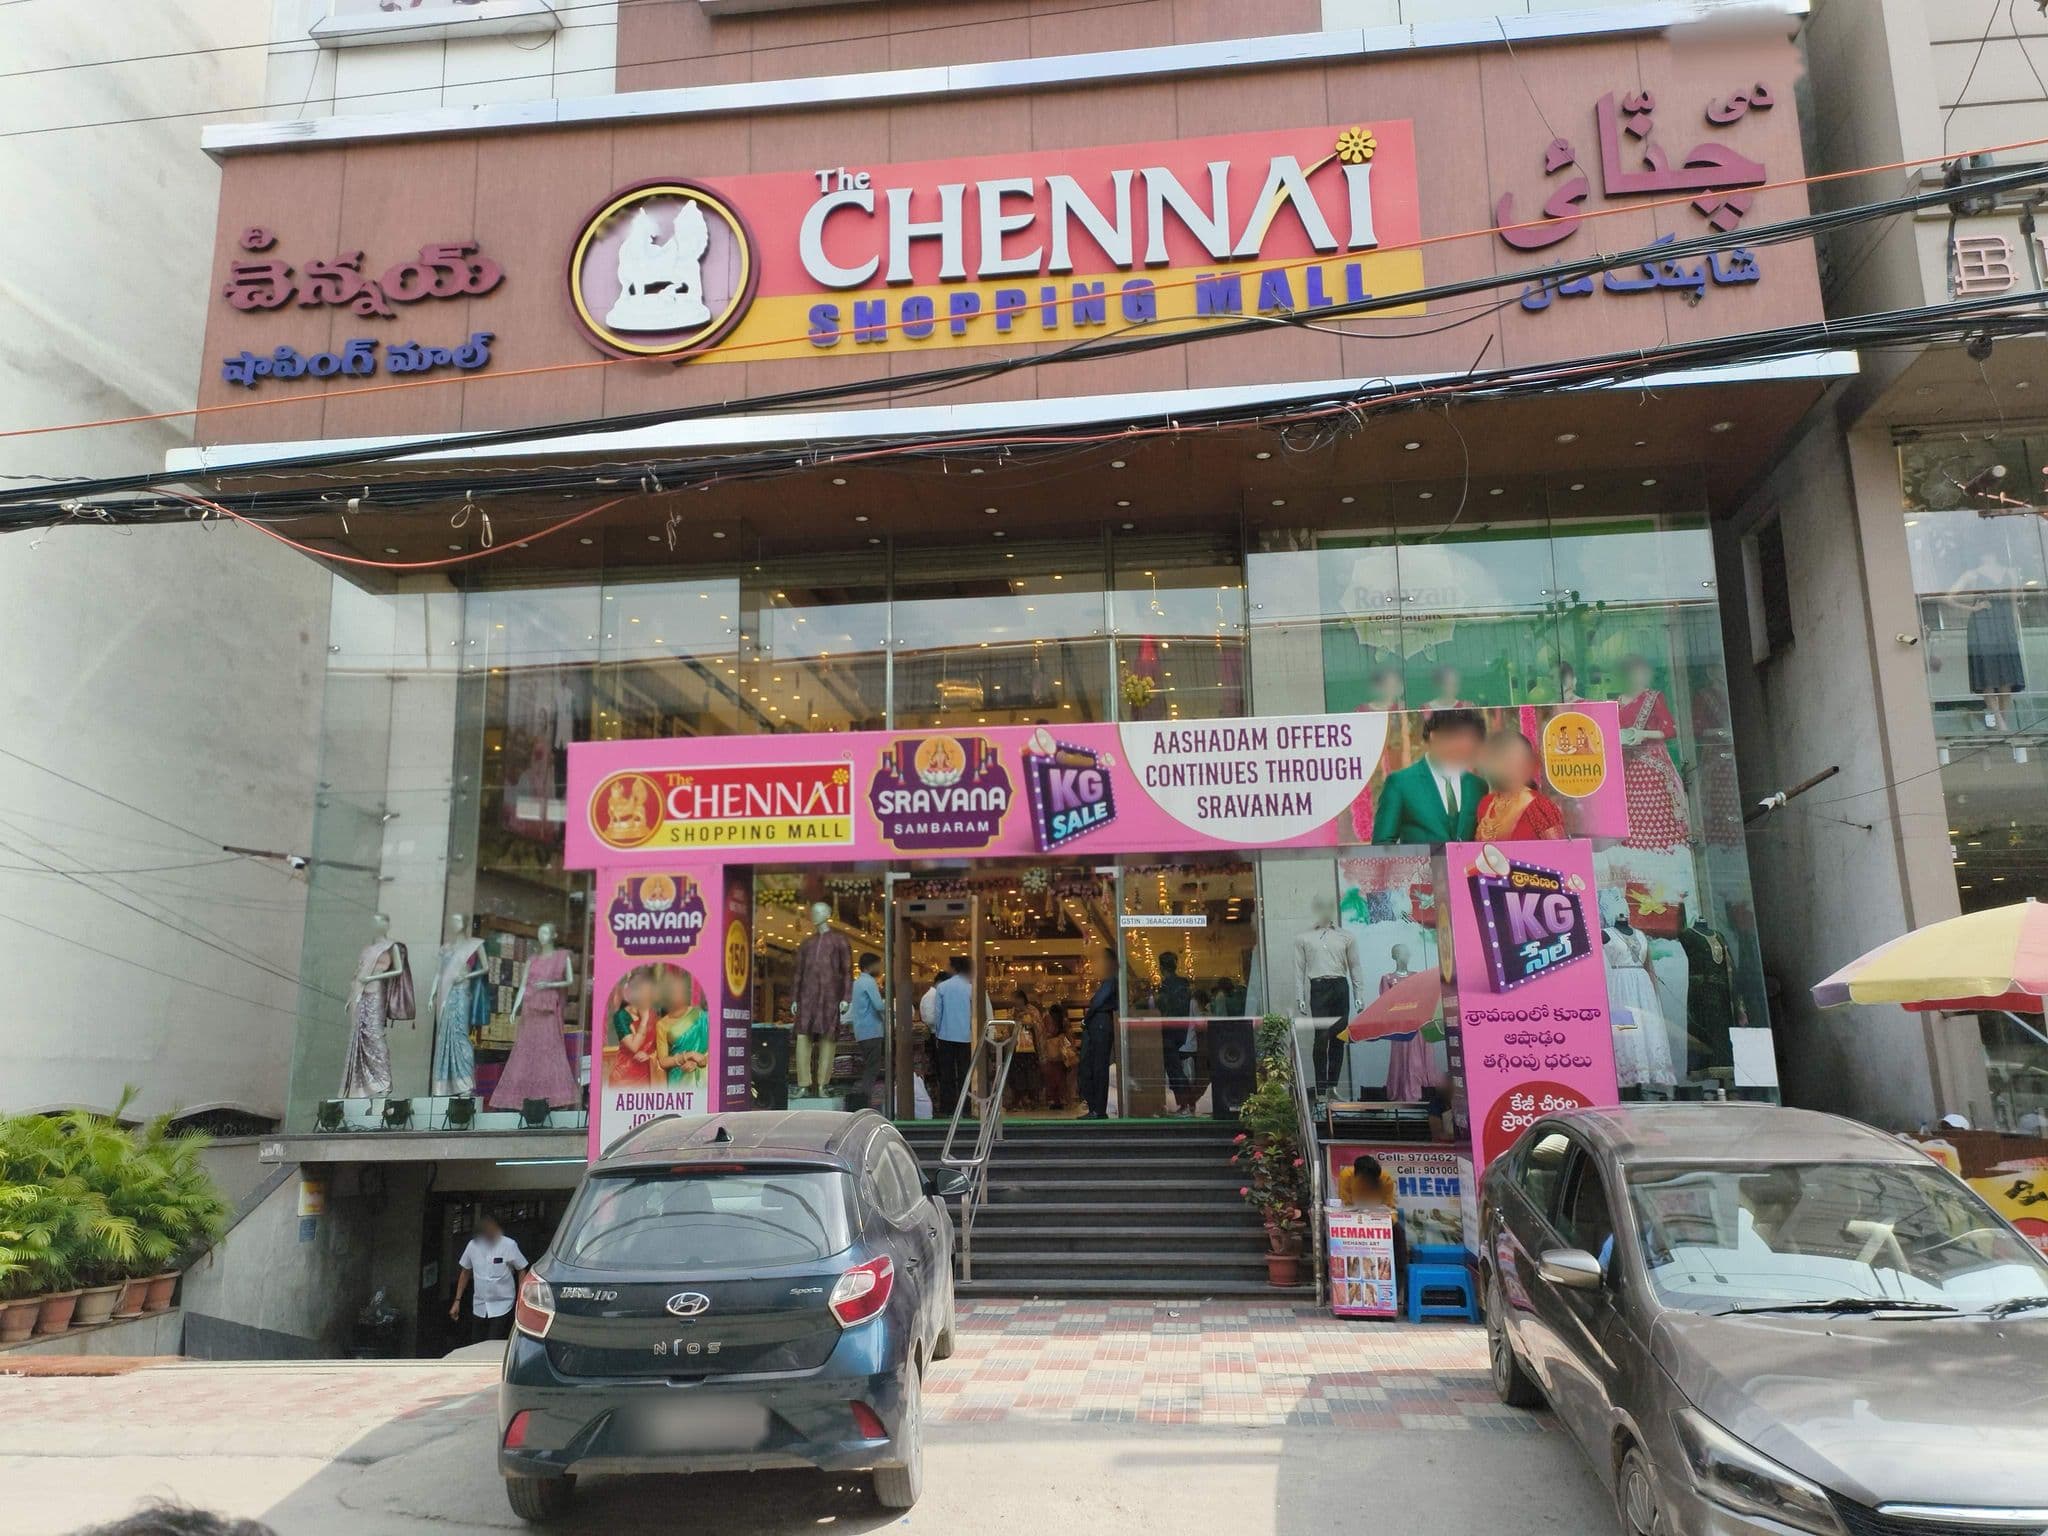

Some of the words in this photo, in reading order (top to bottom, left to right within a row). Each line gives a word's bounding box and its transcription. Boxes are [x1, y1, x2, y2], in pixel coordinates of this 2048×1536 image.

[814, 168, 870, 192] The
[799, 128, 1380, 288] CHENNAI
[240, 226, 278, 252] ది
[808, 278, 1157, 348] SHOPPING
[1195, 262, 1374, 317] MALL
[222, 338, 379, 388] షాపింగ్
[386, 332, 495, 376] మాల్
[1153, 728, 1268, 754] AASHADAM
[1277, 724, 1352, 749] OFFERS
[665, 772, 694, 787] The
[1146, 761, 1258, 787] CONTINUES
[1266, 757, 1363, 783] THROUGH
[1551, 763, 1602, 777] VIVAHA
[667, 768, 850, 819] CHENNAI
[878, 786, 1007, 815] SRAVANA
[1049, 768, 1104, 812] KG
[1197, 792, 1313, 819] SRAVANAM
[894, 821, 990, 835] SAMBARAM
[1052, 801, 1108, 839] SALE
[670, 824, 776, 843] SHOPPING
[788, 823, 844, 839] MALL
[1511, 871, 1560, 890] శ్రావణం
[613, 911, 703, 931] SRAVANA
[1121, 917, 1140, 925] GSTIN
[1505, 892, 1575, 945] KG
[624, 936, 691, 945] SAMBARAM
[1519, 932, 1573, 974] సేల్
[1465, 1004, 1549, 1027] శ్రావణంలో
[1553, 1008, 1601, 1022] కూడా
[1483, 1053, 1541, 1072] తగ్గింపు
[1545, 1054, 1592, 1071] ధరలు
[616, 1092, 694, 1111] ABUNDANT
[1510, 1093, 1535, 1111] కేజీ
[1377, 1152, 1404, 1162] Cell:
[1331, 1227, 1391, 1239] HEMANTH
